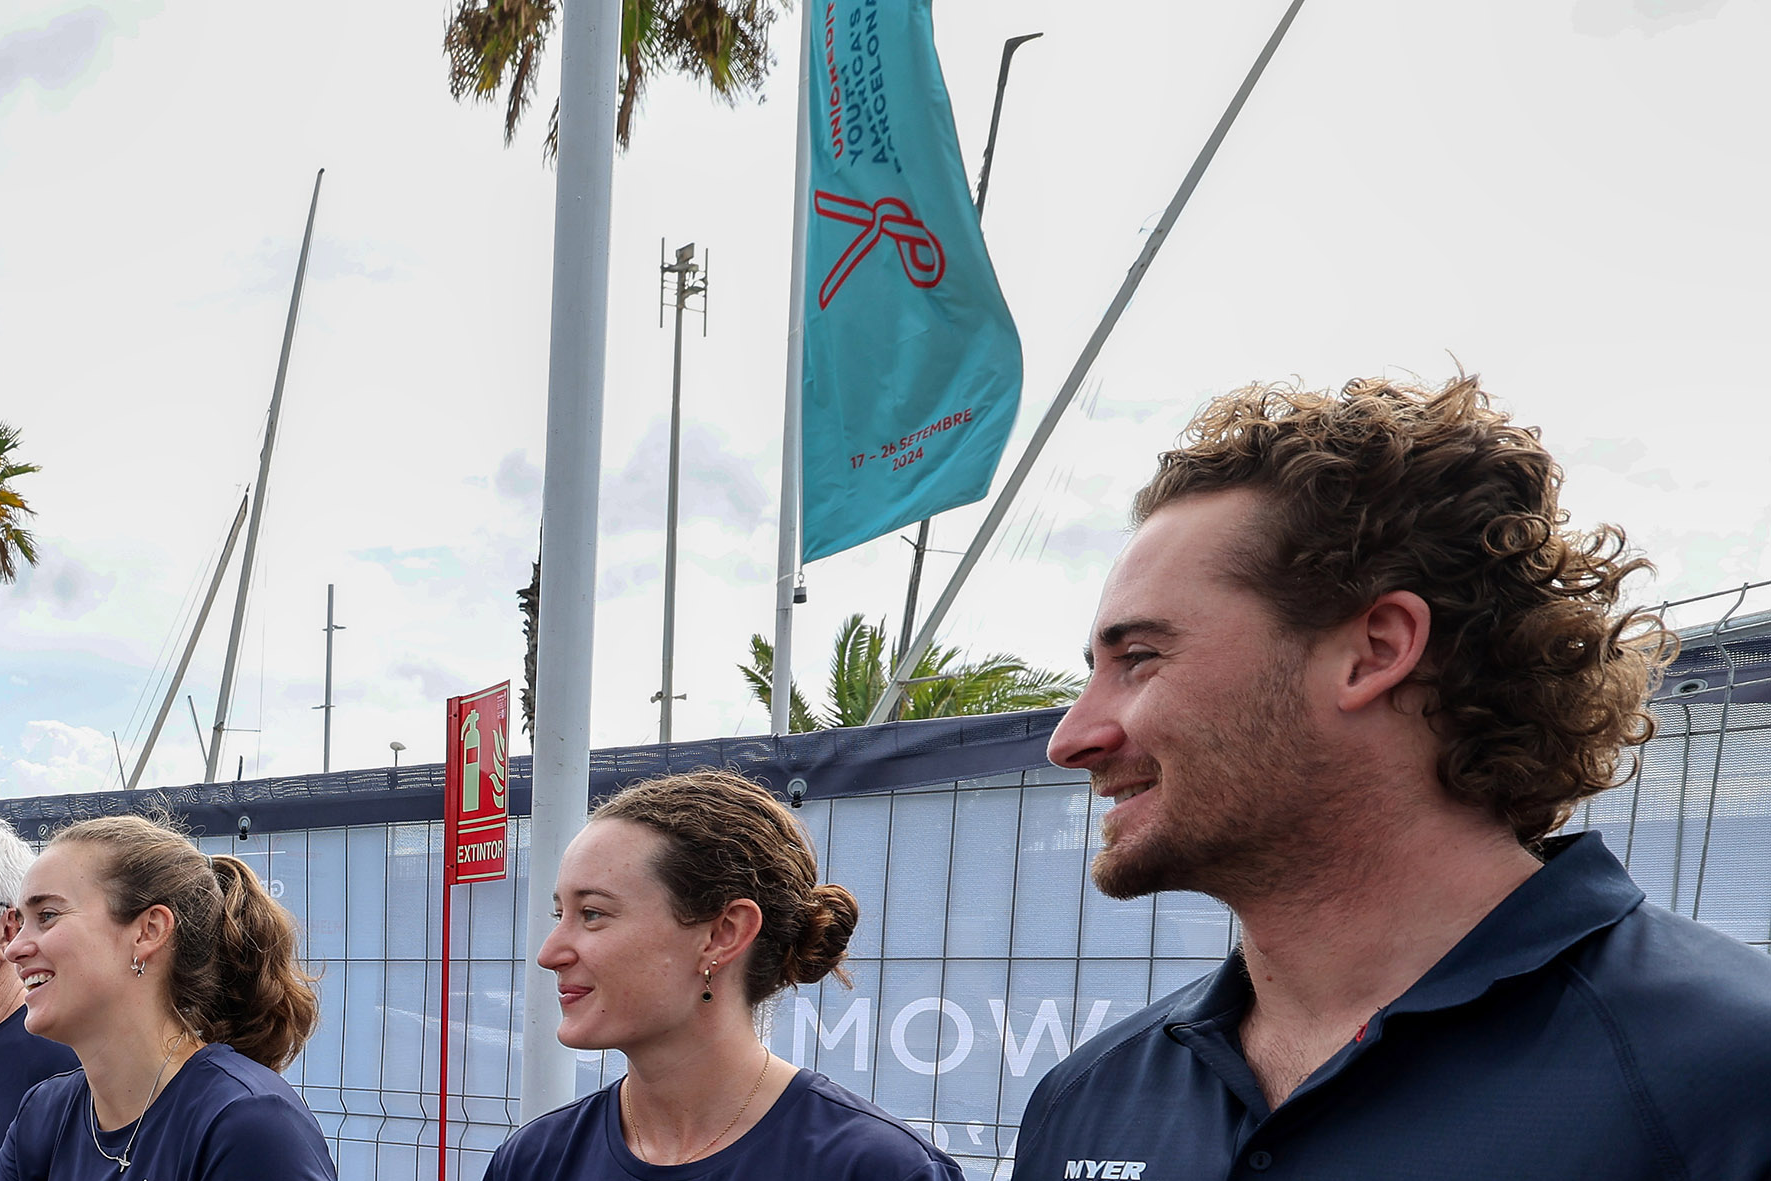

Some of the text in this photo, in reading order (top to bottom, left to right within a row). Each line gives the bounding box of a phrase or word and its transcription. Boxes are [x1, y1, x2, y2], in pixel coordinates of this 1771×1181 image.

[850, 453, 865, 469] 17
[881, 442, 897, 459] 26
[899, 408, 973, 451] SETEMBRE
[892, 446, 925, 471] 2024
[456, 839, 504, 864] EXTINTOR
[1064, 1160, 1147, 1181] MYER
